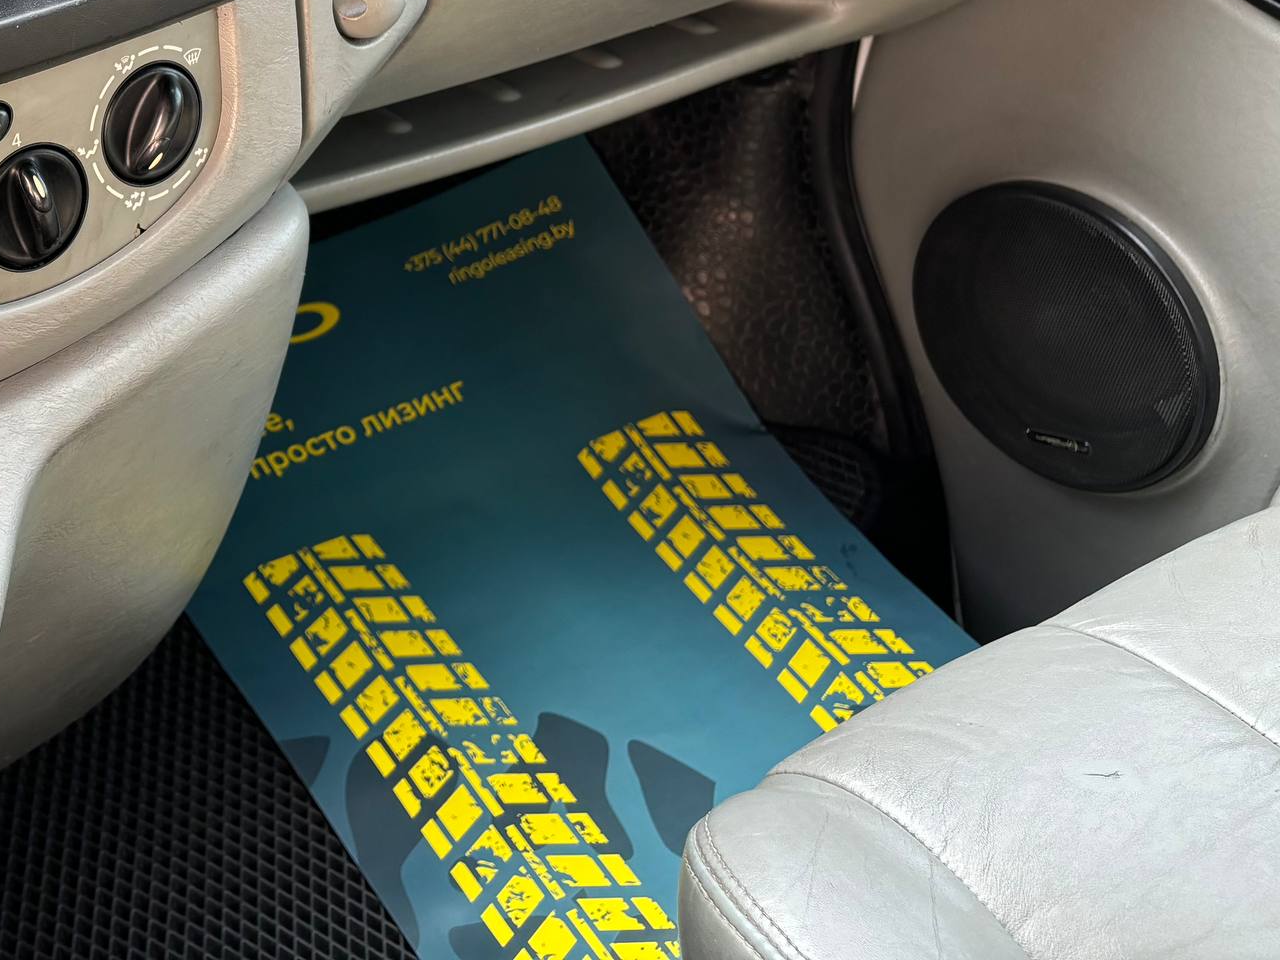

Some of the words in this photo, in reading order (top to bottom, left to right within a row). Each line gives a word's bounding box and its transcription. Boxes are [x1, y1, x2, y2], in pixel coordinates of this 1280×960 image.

[11, 132, 22, 148] 4
[403, 247, 444, 272] +375
[441, 232, 480, 263] (44)
[475, 194, 563, 245] 771-08-48
[448, 218, 576, 286] ringoleasing.by
[250, 425, 358, 480] просто
[360, 380, 465, 439] лизинг
